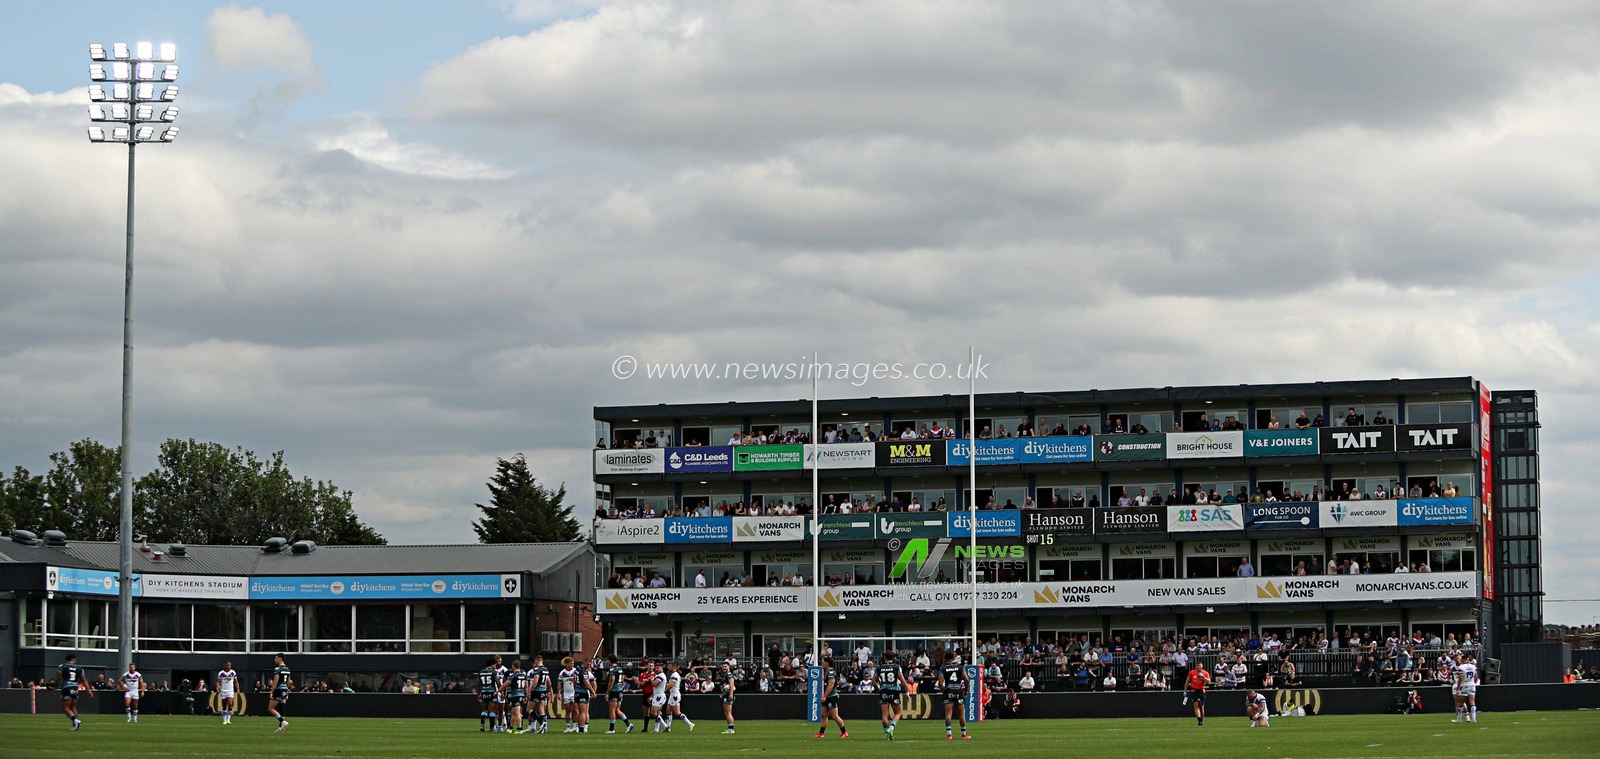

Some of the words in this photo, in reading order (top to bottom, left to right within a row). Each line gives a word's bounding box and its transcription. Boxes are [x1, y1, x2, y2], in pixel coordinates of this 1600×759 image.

[1249, 439, 1268, 447] V&E
[1271, 437, 1313, 447] JOINERS
[1332, 431, 1381, 449] TAIT
[1409, 428, 1458, 446] TAIT
[890, 444, 931, 457] M&M
[952, 444, 1014, 458] diykitchens
[1024, 442, 1087, 456] diykitchens
[1176, 443, 1204, 451] BRIGHT
[1206, 442, 1233, 450] HOUSE
[606, 454, 652, 465] laminates
[1201, 509, 1232, 521] SAS
[1253, 508, 1278, 516] LONG
[1280, 506, 1311, 515] SPOON
[1402, 503, 1467, 518] diykitchens
[953, 516, 1016, 530] diykitchens
[1029, 513, 1084, 526] Hanson
[1103, 512, 1159, 524] Hanson
[617, 525, 659, 537] iAspire2
[669, 522, 728, 536] diykitchens
[1027, 535, 1039, 543] SHOT
[1041, 534, 1053, 545] 15
[252, 583, 295, 593] diykitchens
[351, 582, 396, 593] diykitchens
[452, 581, 498, 592] diykitchens
[1285, 580, 1339, 588] MONARCH
[1356, 581, 1468, 592] MONARCHVANS.CO.UK
[842, 590, 894, 598] MONARCH
[1062, 586, 1115, 594] MONARCH
[1197, 587, 1226, 595] SALES
[631, 593, 680, 601] MONARCH
[742, 595, 798, 603] EXPERIENCE
[910, 593, 932, 601] CALL
[935, 593, 950, 601] ON
[982, 592, 998, 600] 330
[481, 676, 492, 684] 15
[880, 672, 895, 682] 18
[950, 672, 958, 682] 4
